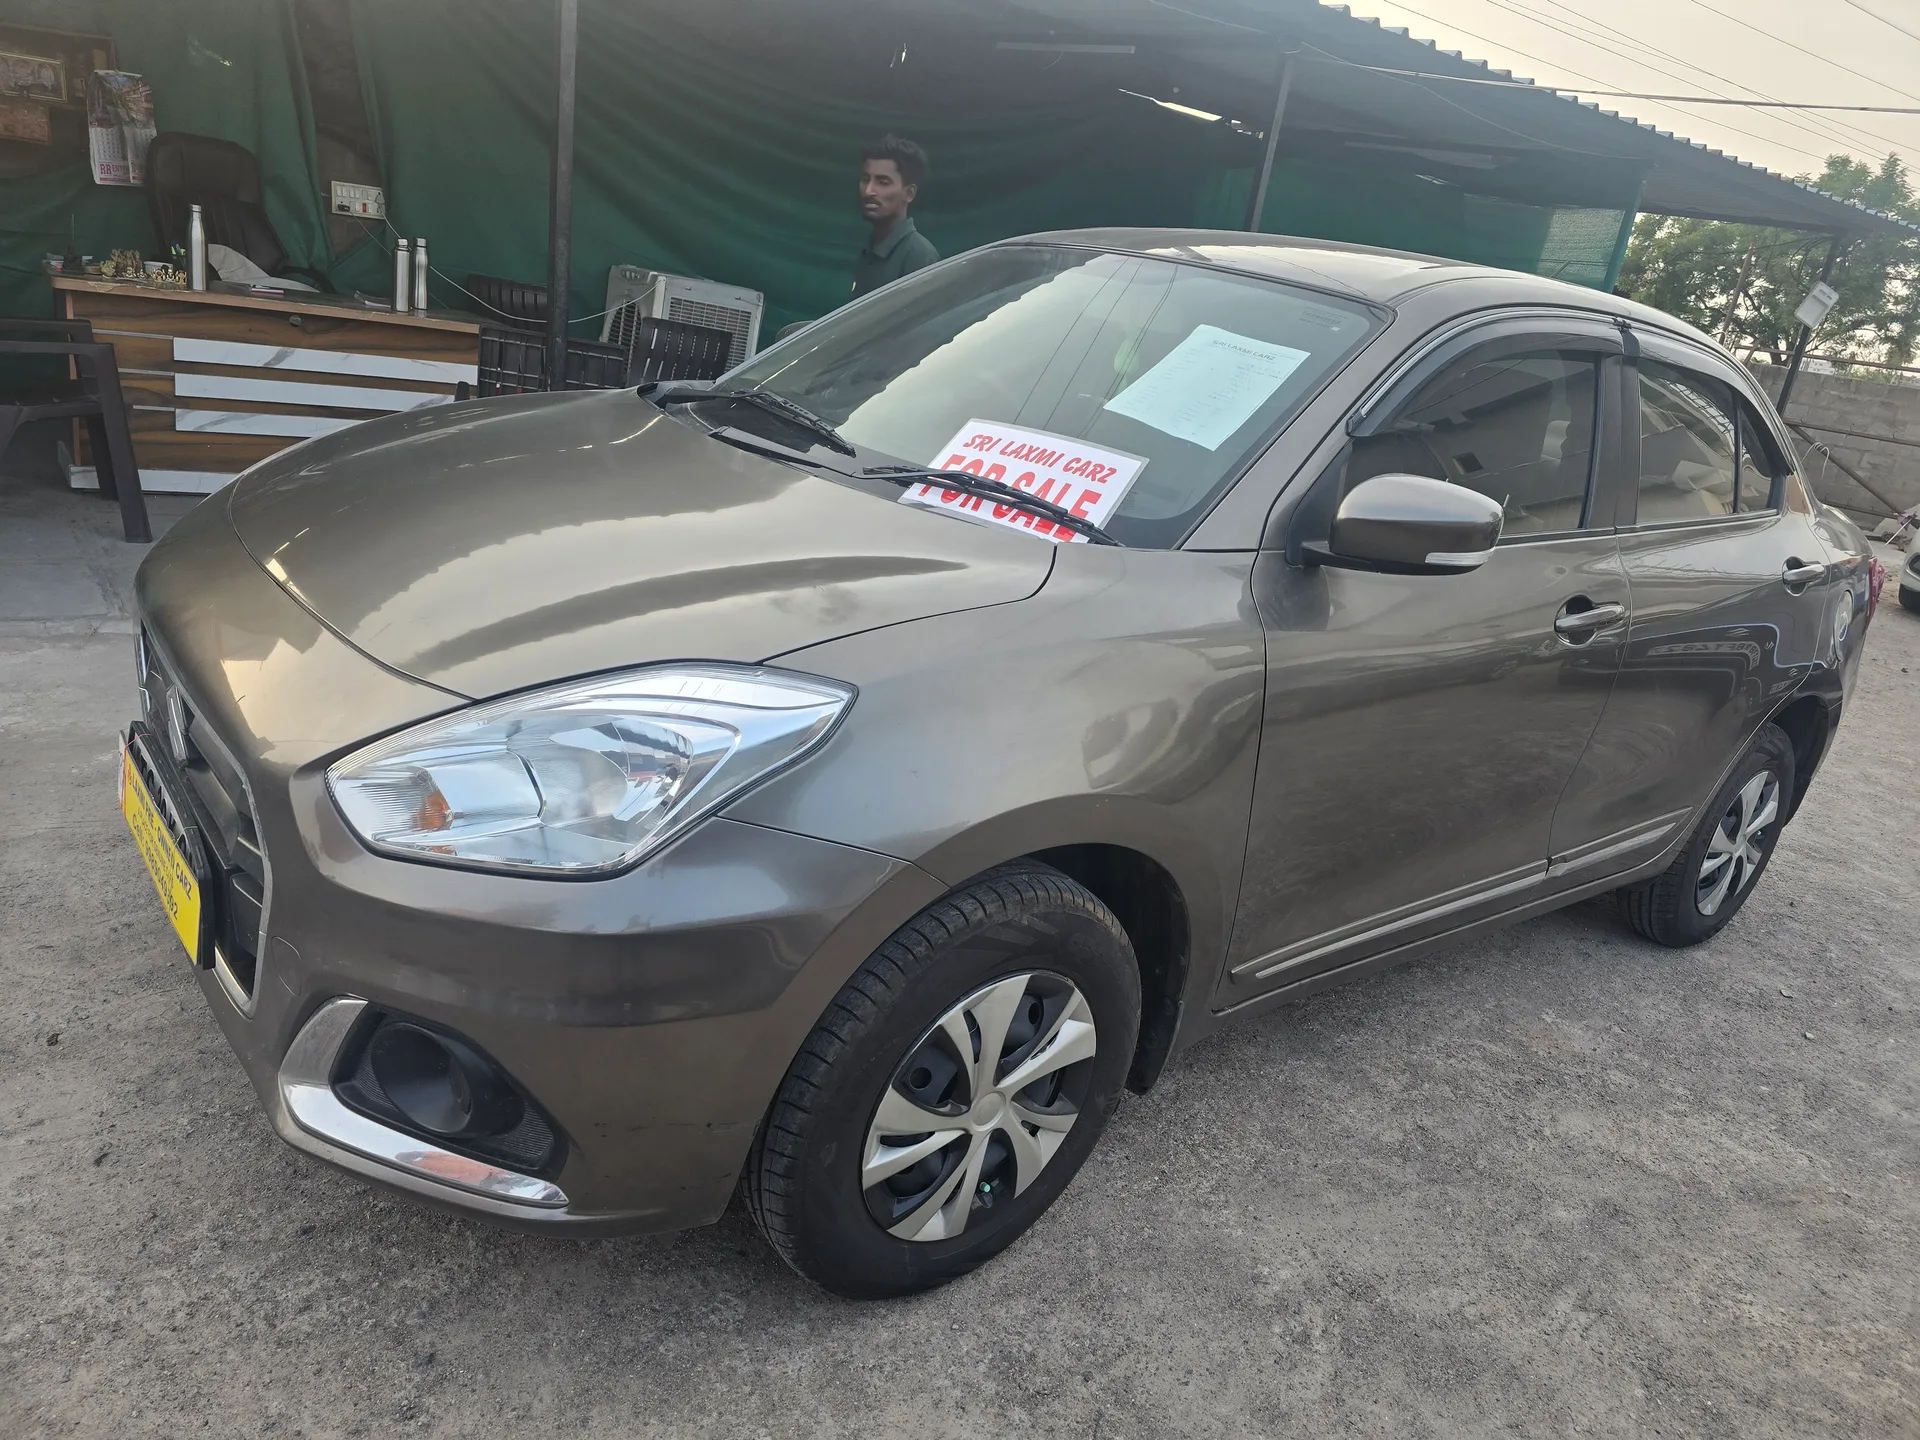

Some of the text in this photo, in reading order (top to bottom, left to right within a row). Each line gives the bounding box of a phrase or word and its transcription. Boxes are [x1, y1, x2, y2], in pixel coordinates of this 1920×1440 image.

[1228, 343, 1252, 355] LAXMI
[1253, 351, 1276, 361] CARZ
[963, 434, 1117, 484] SRI LAXMI CARZ
[175, 861, 192, 902] CARZ
